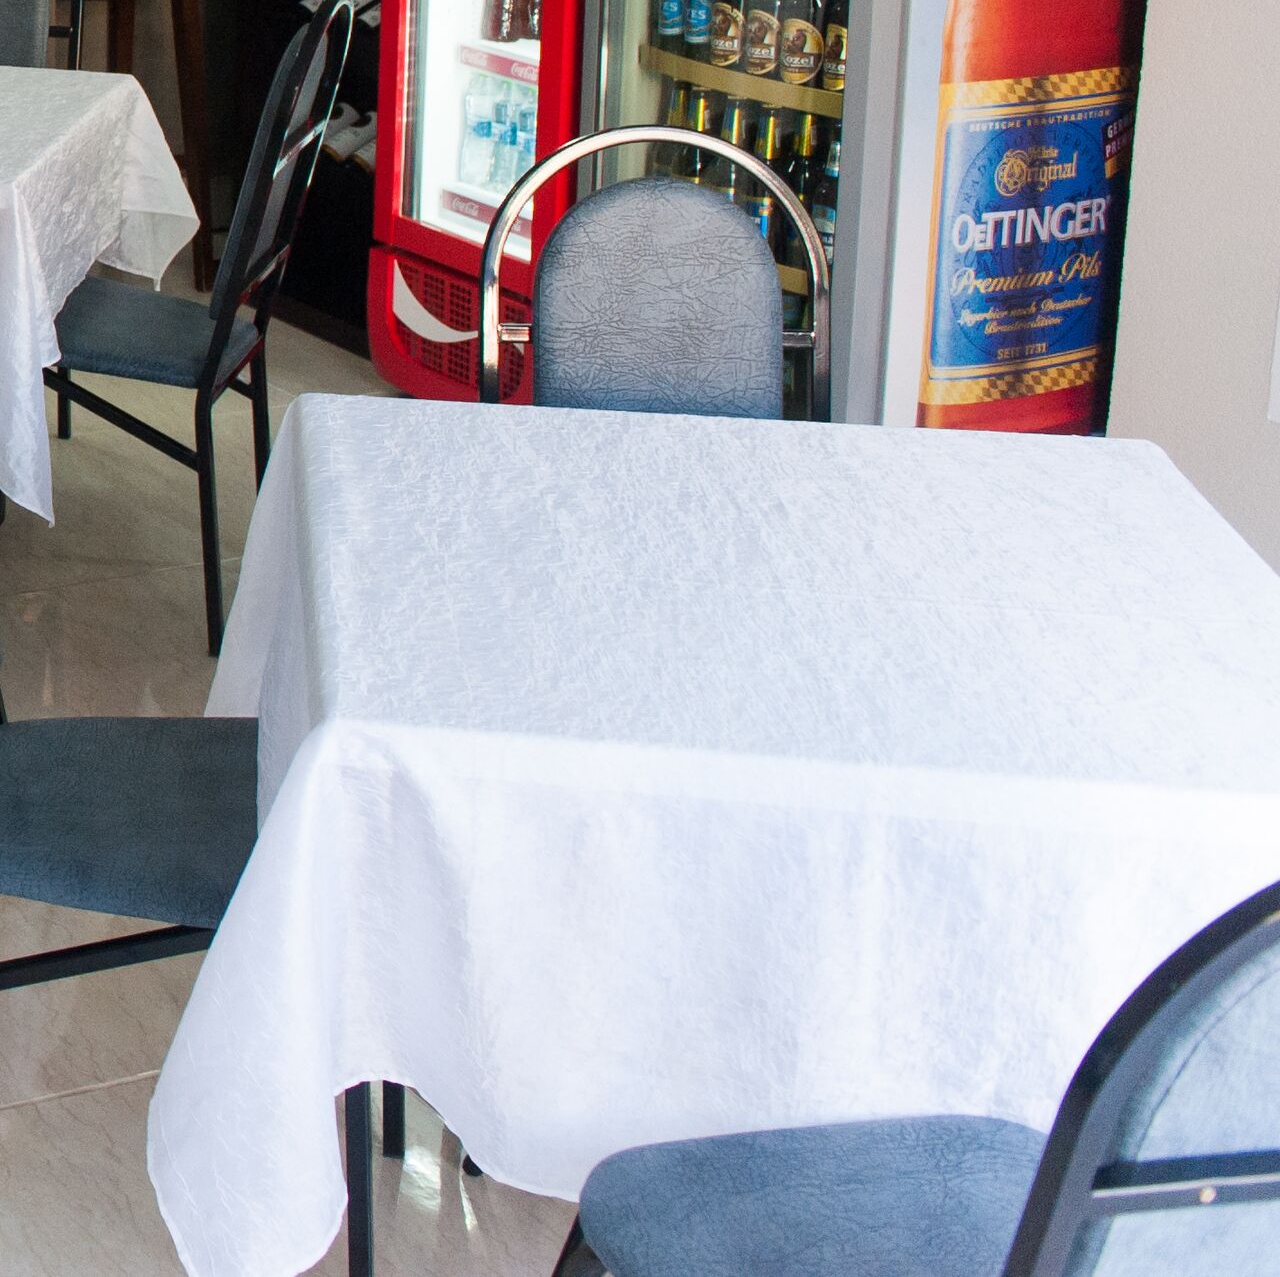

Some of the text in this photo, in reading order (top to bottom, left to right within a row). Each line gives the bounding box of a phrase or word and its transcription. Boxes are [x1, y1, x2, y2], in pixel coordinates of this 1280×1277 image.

[950, 266, 1055, 297] Premium
[1058, 249, 1103, 284] Pils
[997, 345, 1022, 360] SEIT
